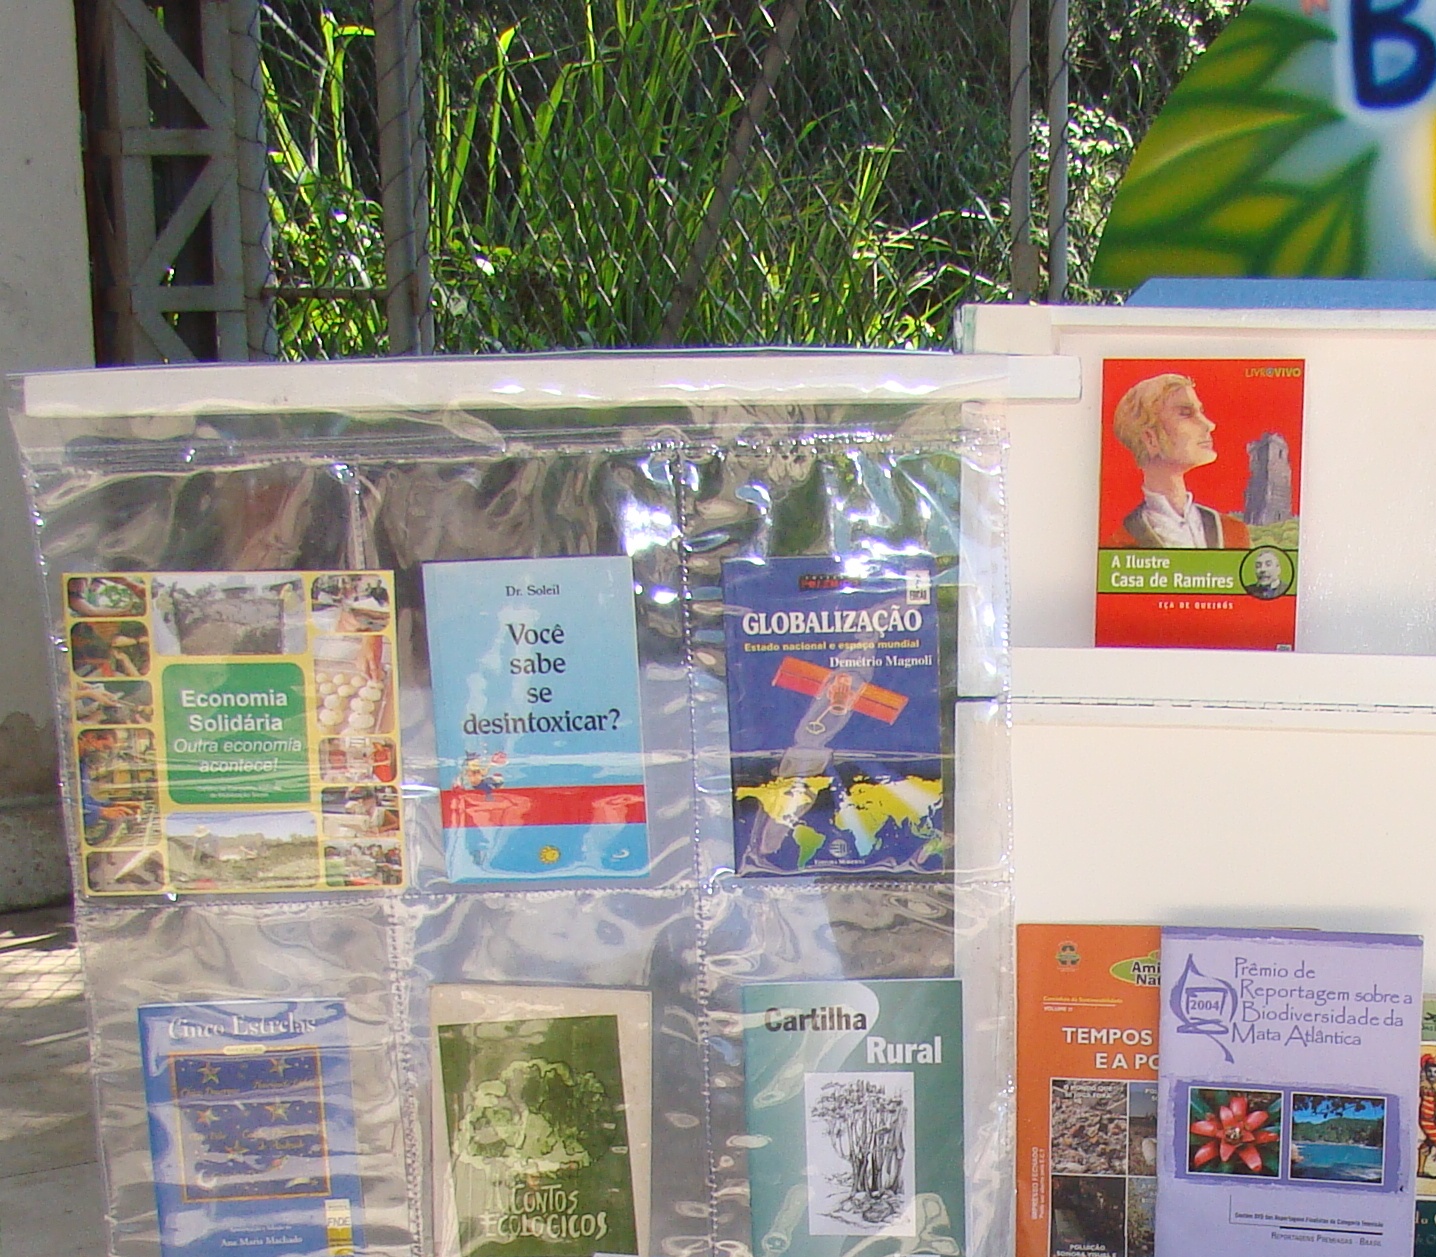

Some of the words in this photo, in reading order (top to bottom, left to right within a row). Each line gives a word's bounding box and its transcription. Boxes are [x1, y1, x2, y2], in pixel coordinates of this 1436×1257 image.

[1111, 555, 1120, 569] A
[1126, 555, 1170, 569] Ilustre
[1111, 572, 1143, 587] Casa
[1150, 573, 1167, 588] de
[1173, 573, 1233, 588] Ramires
[505, 585, 523, 597] Dr.
[528, 584, 560, 596] Soleil
[742, 605, 922, 638] GLOBALIZAÇÃO
[508, 624, 564, 645] Você
[744, 642, 780, 652] Estado
[783, 642, 826, 651] nacional
[838, 642, 875, 653] espaço
[877, 639, 919, 650] mundial
[510, 653, 566, 675] sabe
[829, 655, 882, 669] Demétrio
[885, 654, 932, 669] Magnoli
[181, 689, 288, 707] Economia
[527, 686, 553, 704] se
[189, 714, 283, 731] Solidária
[463, 708, 620, 735] desintoxicar?
[174, 739, 218, 752] Outra
[223, 737, 302, 752] economia
[200, 758, 278, 773] acontece!
[1131, 962, 1160, 974] Ami
[1234, 956, 1289, 979] Prêmio
[1293, 960, 1316, 979] de
[1240, 978, 1350, 1006] Reportagem
[1355, 984, 1400, 1004] sobre
[1403, 995, 1413, 1005] a
[1190, 1000, 1219, 1011] 2004
[1242, 1000, 1380, 1027] Biodiversidade
[1383, 1008, 1404, 1027] da
[168, 1017, 225, 1039] Cinco
[232, 1012, 316, 1036] Estrelas
[764, 1007, 867, 1032] Cartilha
[1062, 1027, 1153, 1046] TEMPOS
[1231, 1021, 1282, 1044] Mata
[1284, 1024, 1362, 1047] Atlântica
[866, 1036, 942, 1065] Rural
[1095, 1053, 1108, 1069] E
[1111, 1053, 1128, 1069] A
[240, 1237, 263, 1246] Maria
[266, 1235, 303, 1245] Machado
